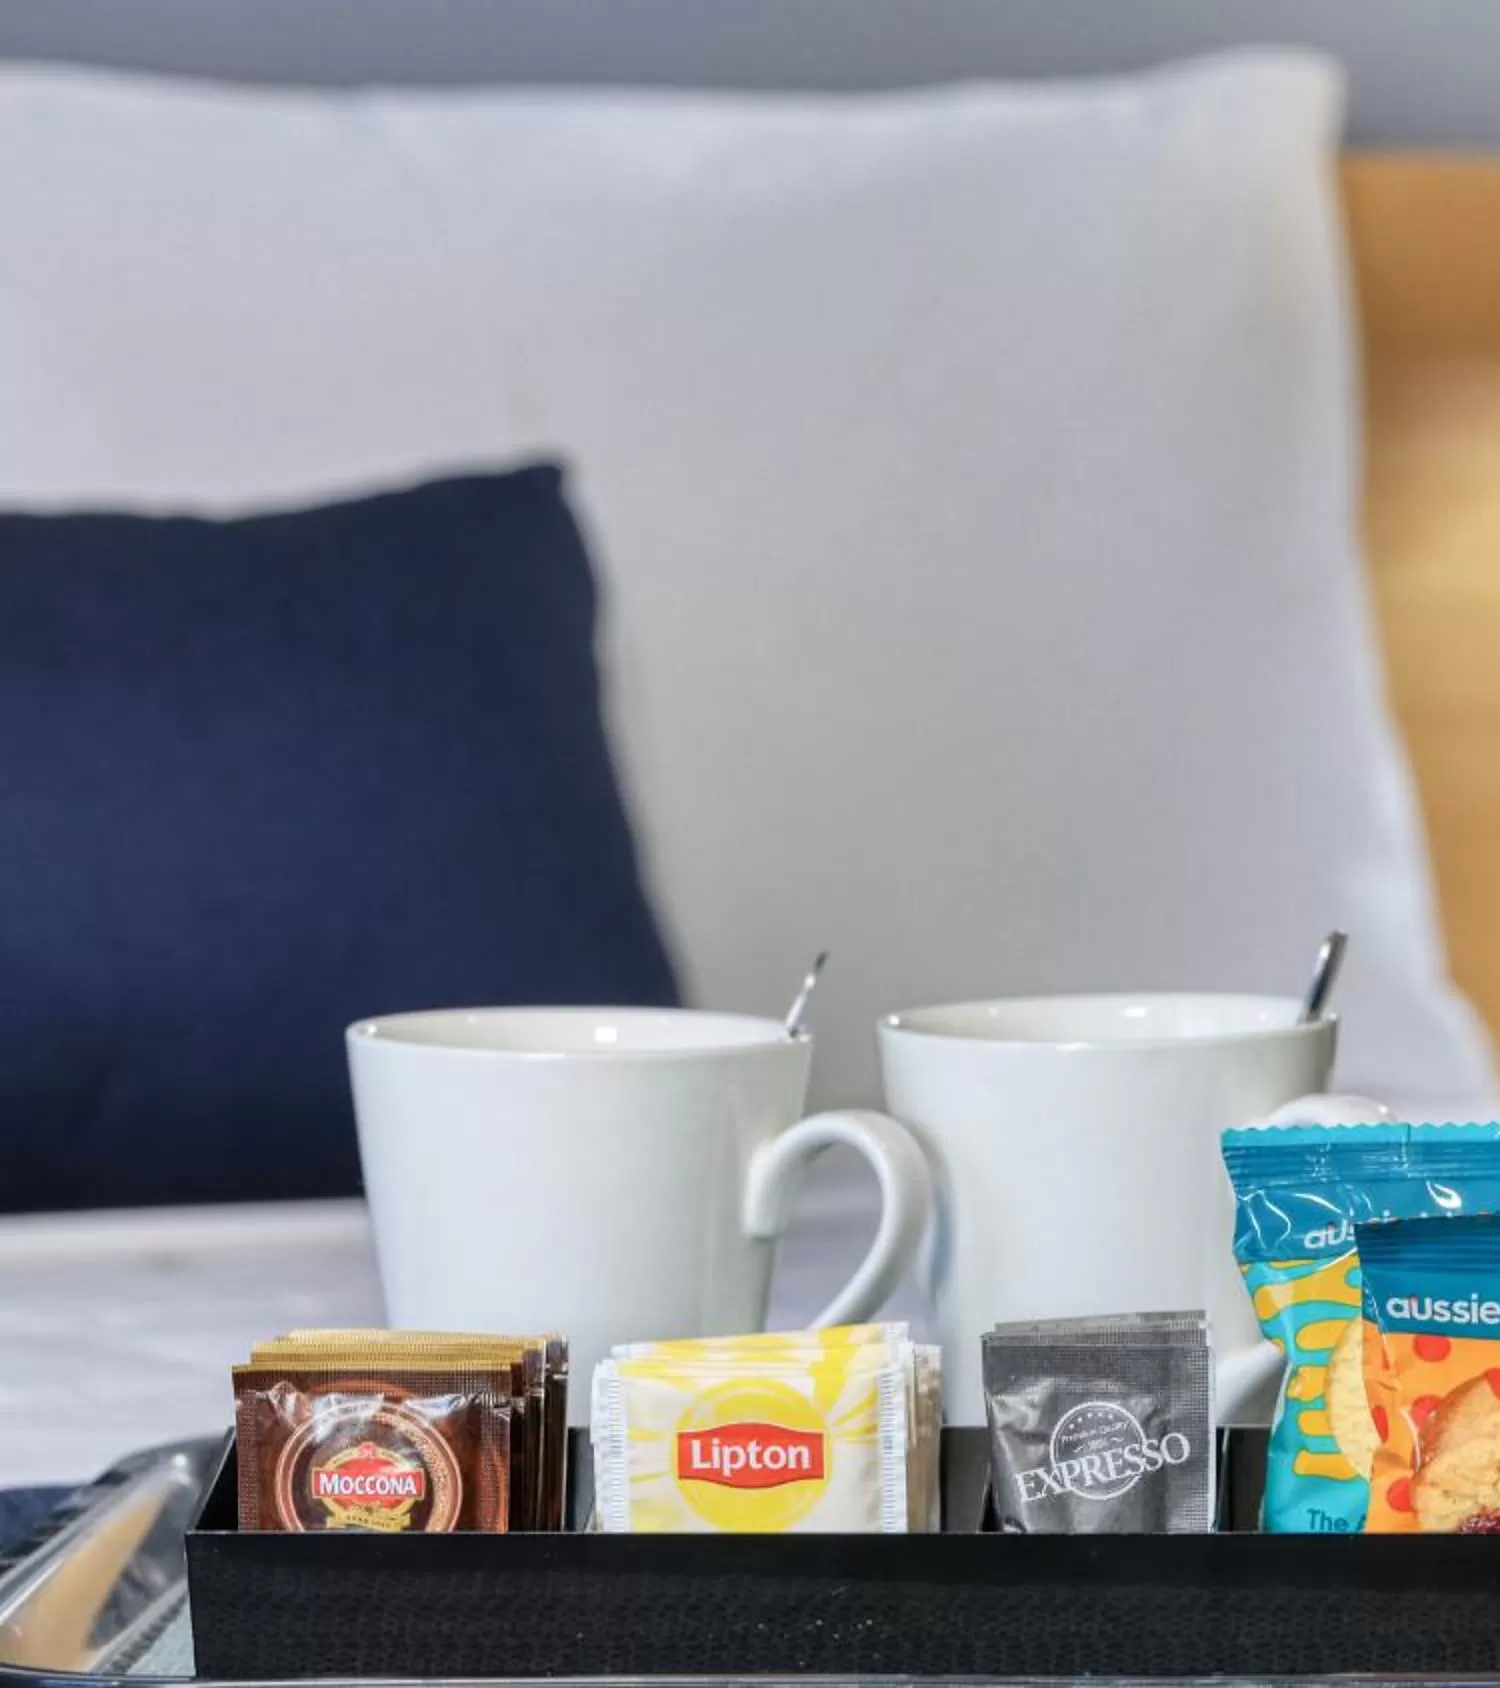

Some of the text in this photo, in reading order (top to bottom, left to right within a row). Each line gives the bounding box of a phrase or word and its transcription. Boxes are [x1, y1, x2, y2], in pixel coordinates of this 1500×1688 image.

[690, 1437, 812, 1478] Lipton
[1014, 1431, 1192, 1504] EXPRESSO
[319, 1472, 417, 1496] MOCCONA
[1306, 1507, 1350, 1533] The
